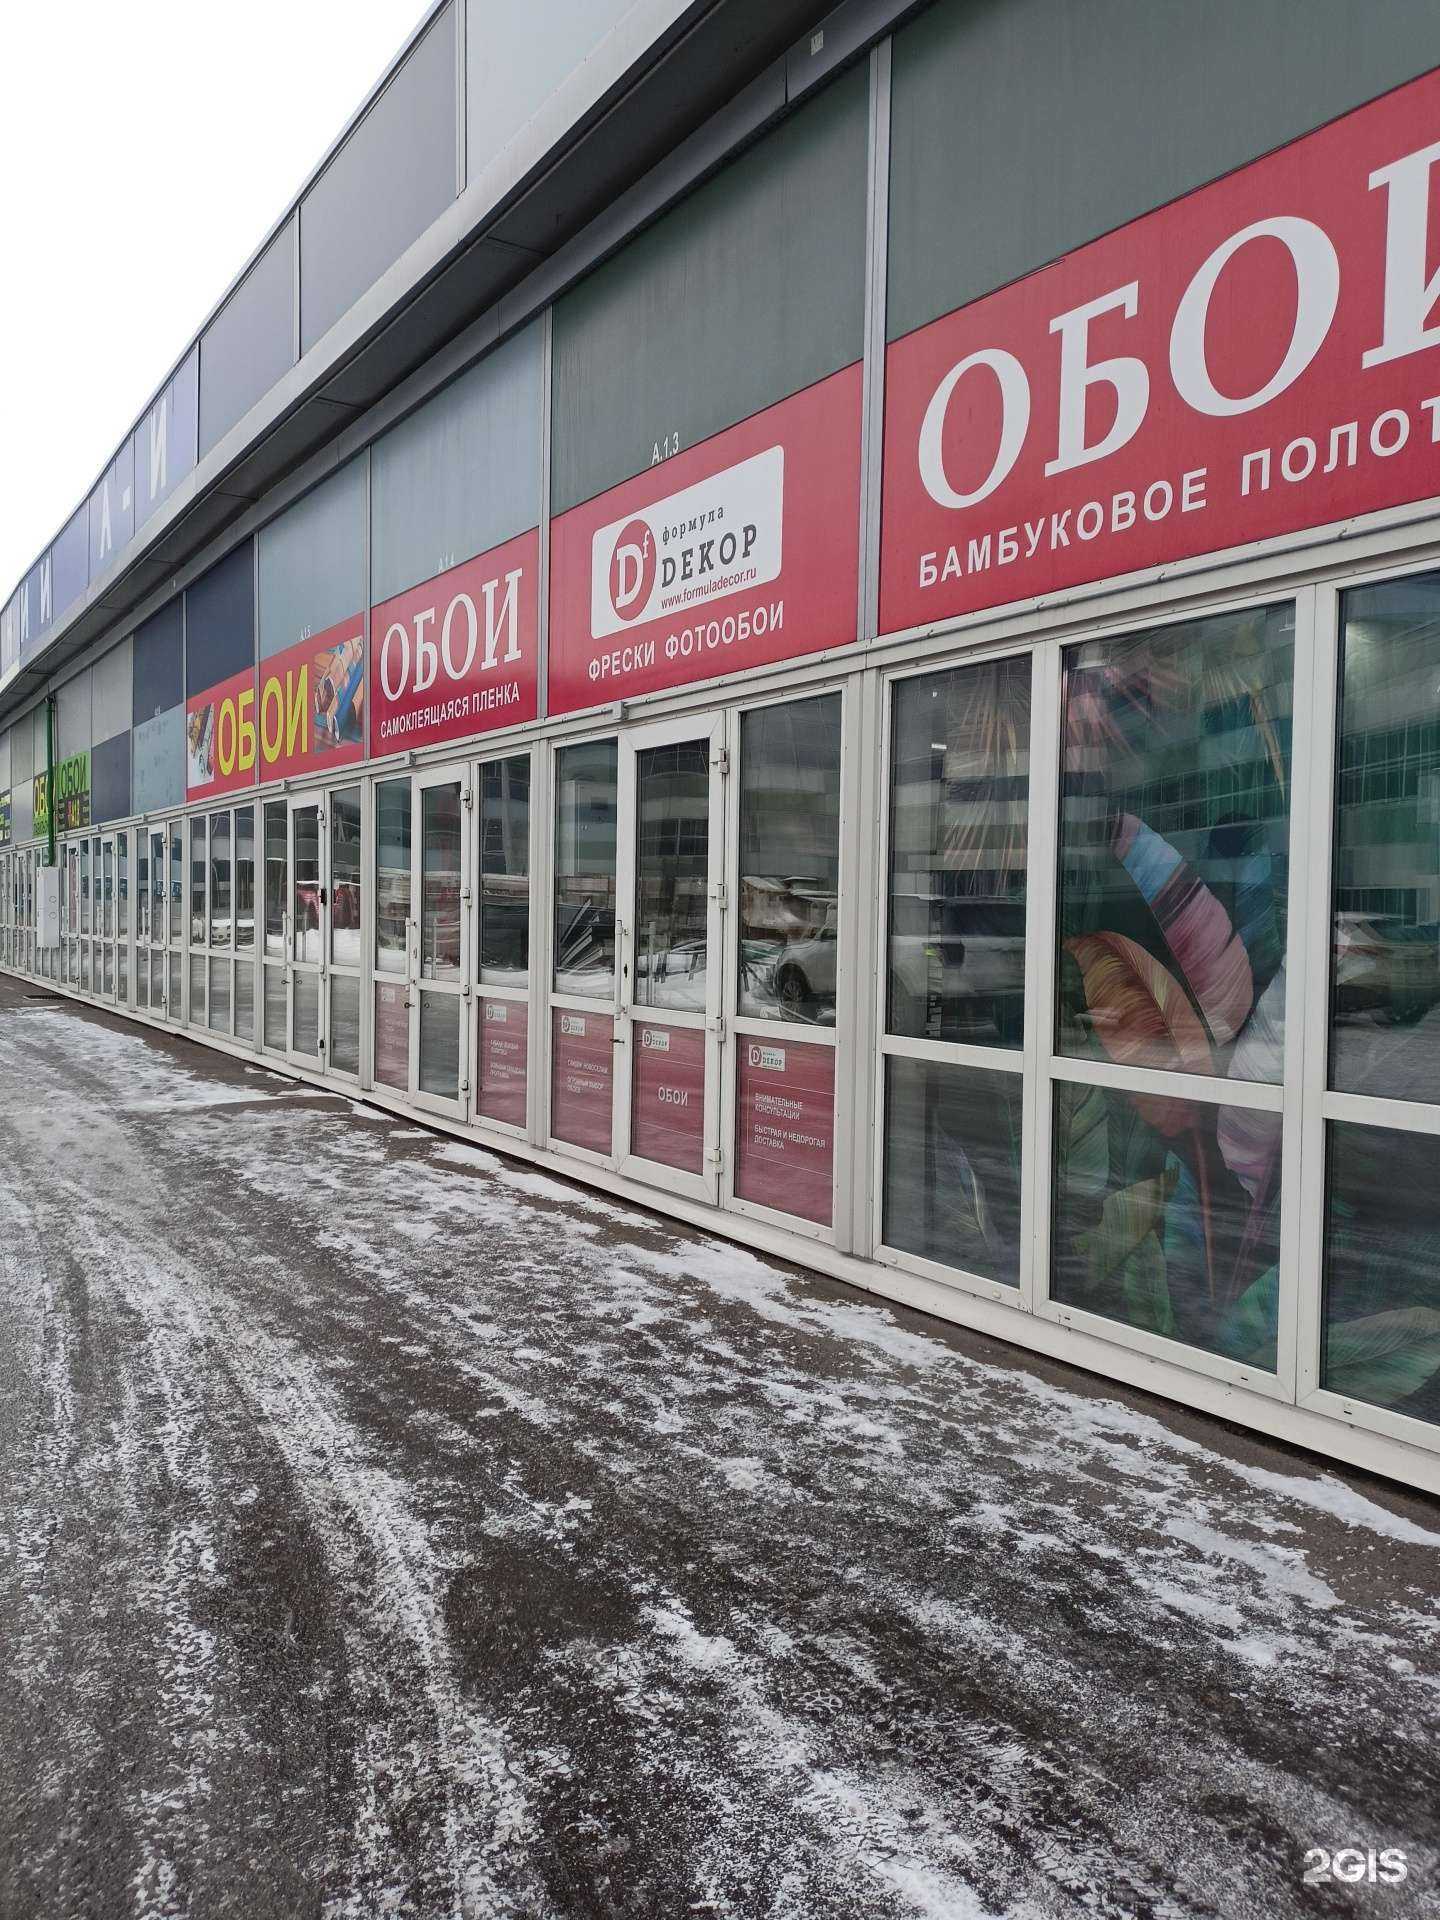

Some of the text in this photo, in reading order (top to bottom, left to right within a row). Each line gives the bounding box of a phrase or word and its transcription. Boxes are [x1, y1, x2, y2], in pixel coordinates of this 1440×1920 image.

[662, 506, 724, 546] формула
[919, 467, 1208, 588] БАМБУКОВОЕ
[661, 567, 757, 610] www.formuladecor.ru
[380, 567, 523, 701] ОБОИ
[589, 601, 784, 682] ФРЕСКИ ФОТООБОИ
[218, 664, 308, 776] ОБОИ
[381, 681, 520, 739] САМОКЛЕЯЩАЯСЯ ПЛЕНКА
[61, 755, 87, 797] ОБОИ
[658, 1086, 688, 1106] ОБОИ
[755, 1093, 803, 1110] ВНИМАТЕЛЬНЫЕ
[755, 1104, 800, 1120] КОНСУЛЬТАЦИИ
[755, 1124, 782, 1138] БЫСТРАЯ
[789, 1132, 825, 1148] НЕДОРОГАЯ
[755, 1135, 785, 1150] ДОСТАВКА
